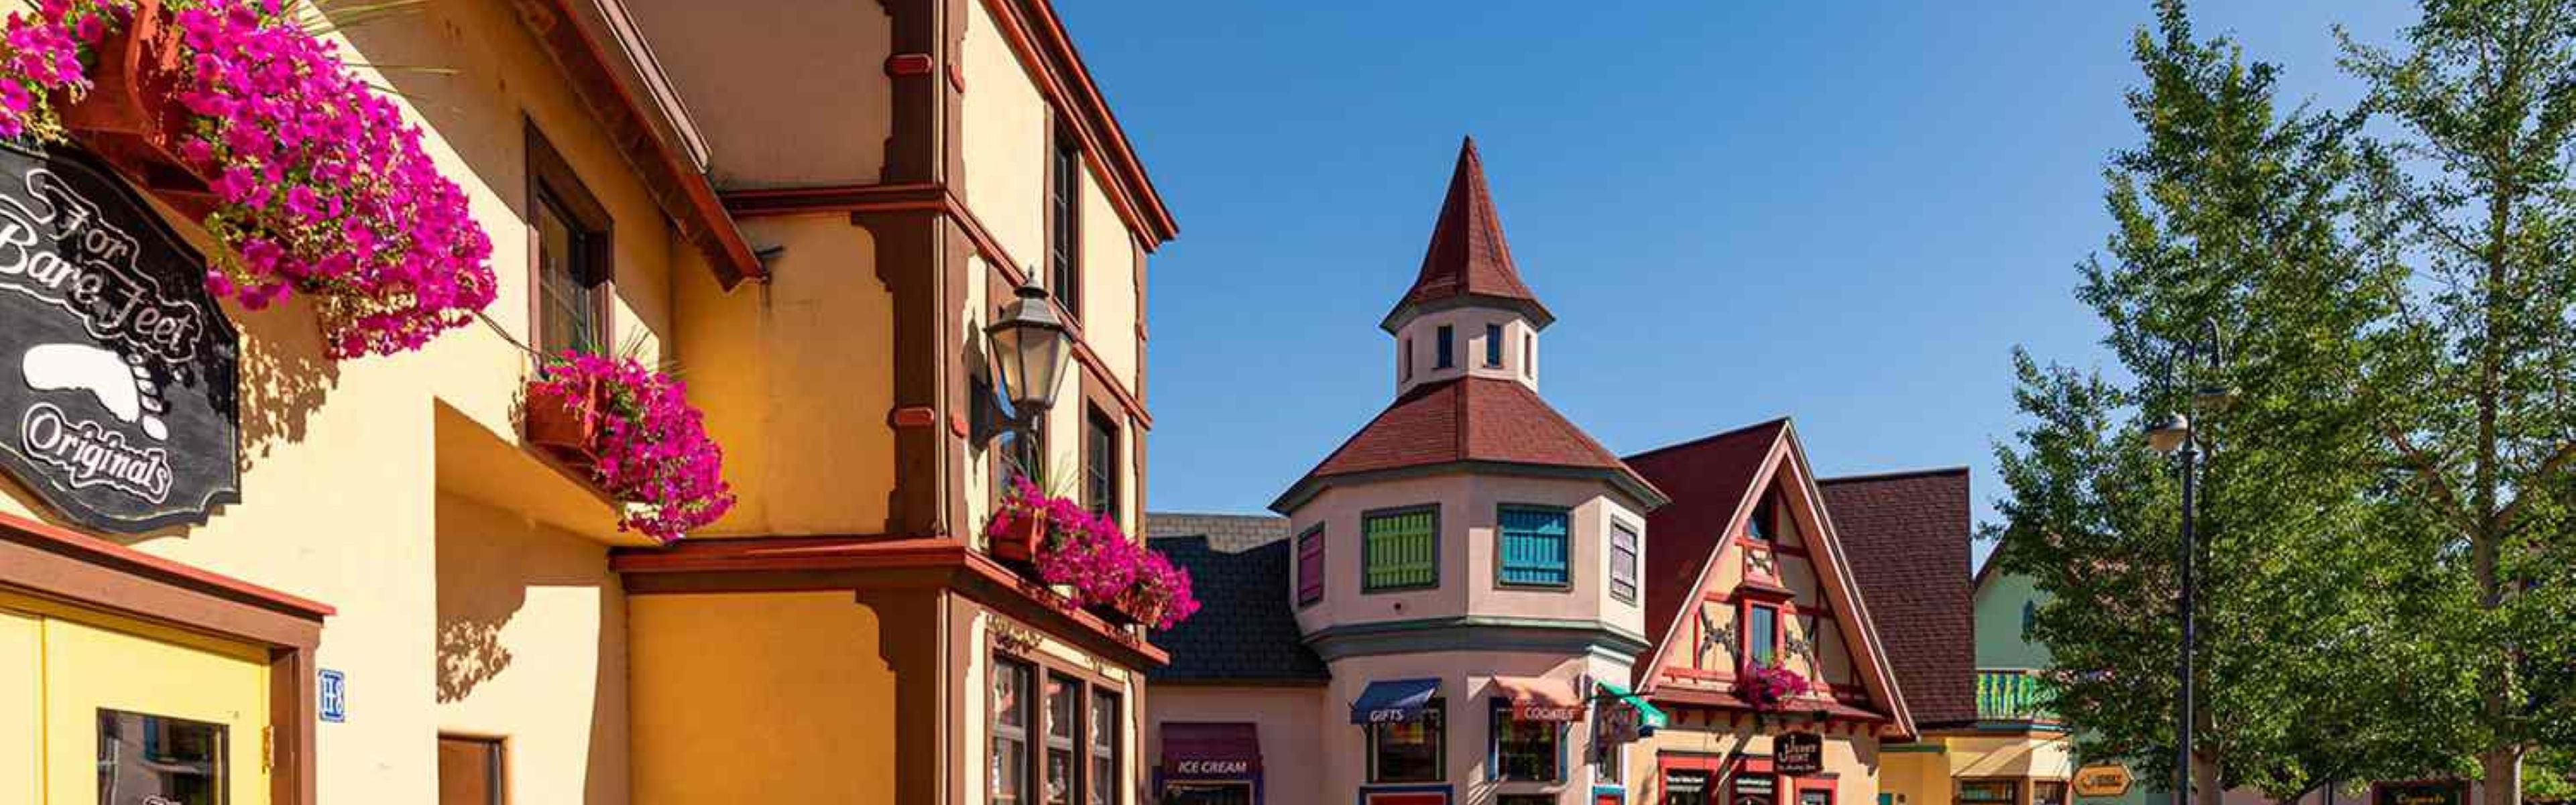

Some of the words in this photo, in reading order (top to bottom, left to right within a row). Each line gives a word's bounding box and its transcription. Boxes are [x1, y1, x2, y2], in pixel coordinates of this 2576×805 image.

[43, 184, 128, 259] For
[0, 208, 103, 304] Bare
[83, 259, 194, 353] Feet
[30, 414, 167, 494] Originals
[1370, 708, 1404, 722] GIFTS
[1524, 707, 1574, 721] COOKIES
[1178, 761, 1199, 773] ICE
[1201, 761, 1247, 773] CREAM
